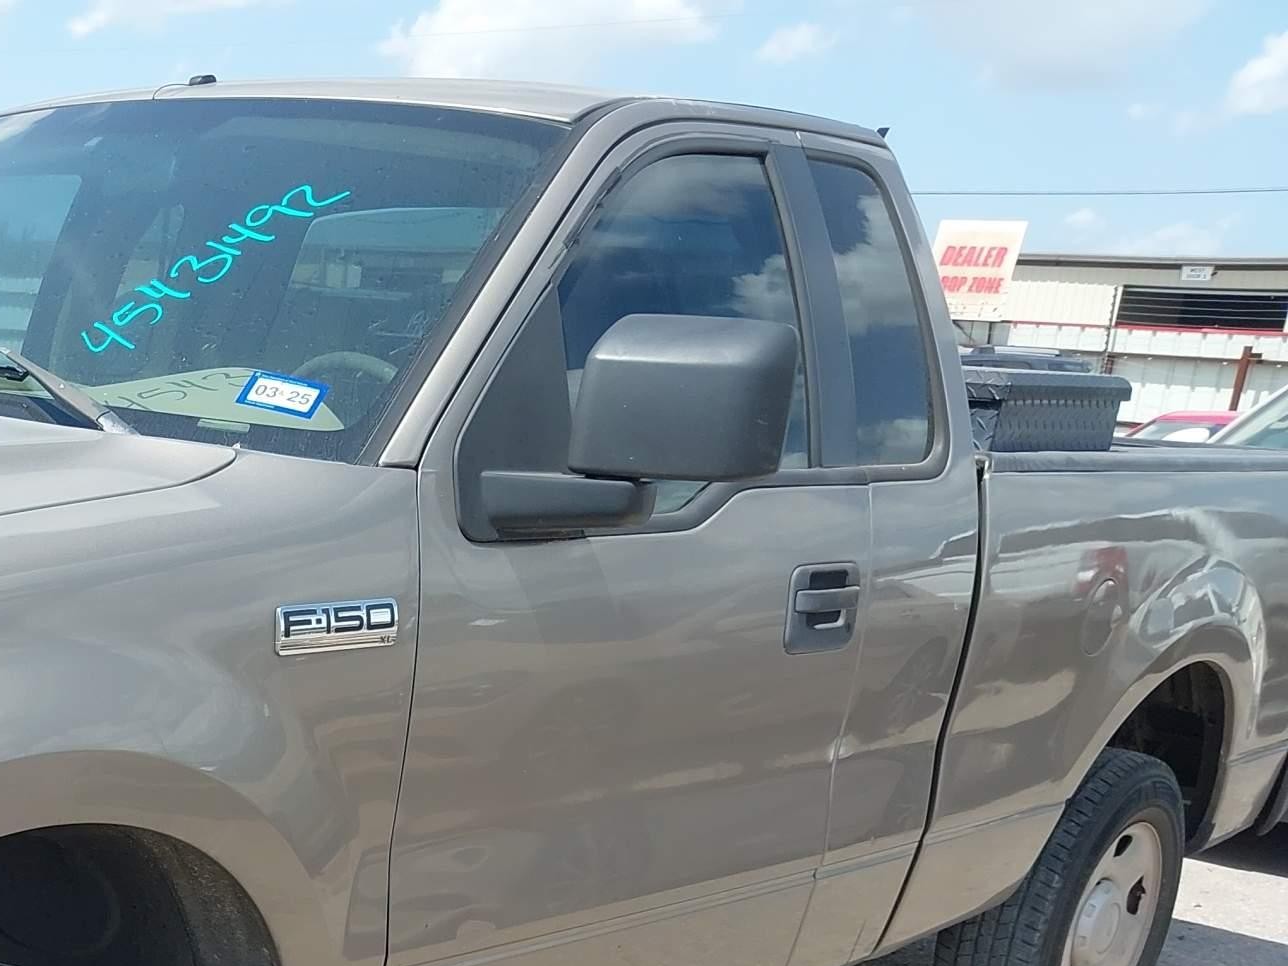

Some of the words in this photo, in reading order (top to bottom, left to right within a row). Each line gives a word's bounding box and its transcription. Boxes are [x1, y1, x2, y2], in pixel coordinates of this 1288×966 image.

[940, 245, 1009, 268] DEALER
[81, 184, 352, 353] 45431492
[941, 275, 968, 293] ROP
[967, 276, 1005, 295] ZONE
[255, 384, 279, 398] 03
[286, 390, 313, 405] 25
